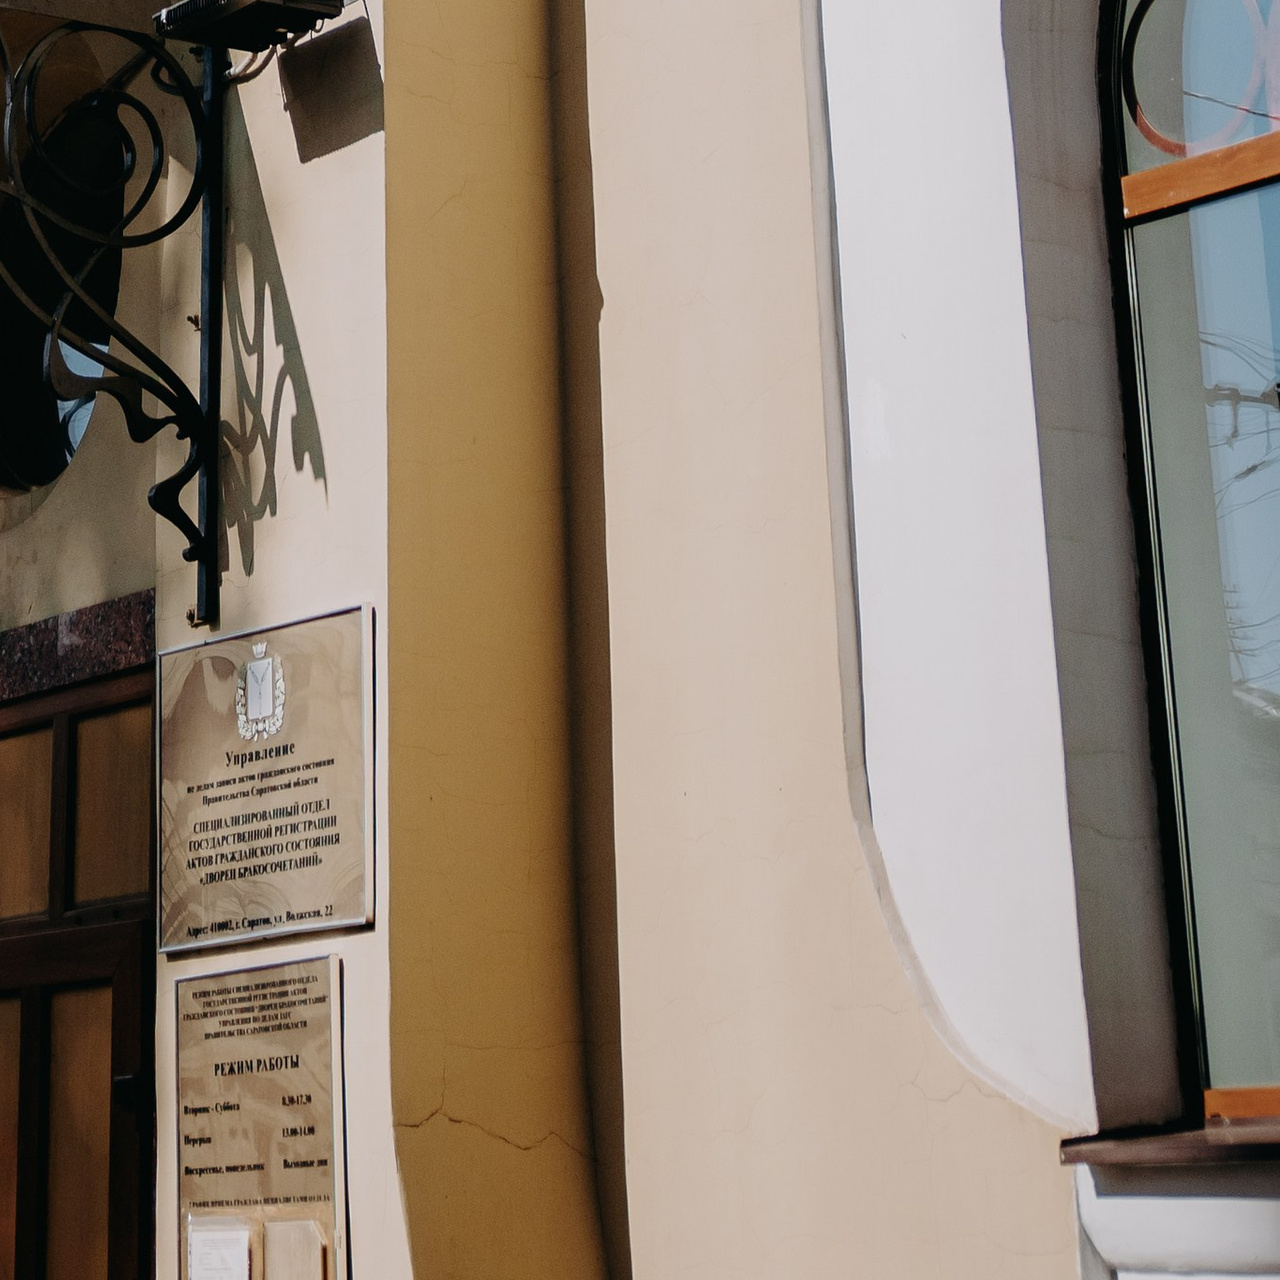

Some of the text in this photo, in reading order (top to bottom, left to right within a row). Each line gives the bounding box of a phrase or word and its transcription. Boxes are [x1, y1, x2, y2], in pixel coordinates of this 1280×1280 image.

[225, 742, 296, 768] Управление
[238, 773, 256, 784] актов
[257, 765, 301, 783] гражданского
[302, 758, 335, 771] состояния
[202, 776, 318, 807] Правительства Саратовской области
[193, 798, 331, 835] СПЕЦИАЛИЗИРОВАННЫЙ ОТДЕЛ
[189, 815, 337, 852] ГОСУДАРСТВЕННОЙ РЕГИСТРАЦИИ
[185, 833, 341, 870] АКТОВ ГРАЖДАНСКОГО СОСТОЯНИЯ
[199, 851, 323, 886] «ДВОРЕЦ БРАКОСОЧЕТАНИЙ»
[186, 926, 209, 938] Адрес:
[325, 905, 333, 917] 22
[214, 1054, 300, 1077] РЕЖИМ РАБОТЫ
[215, 1102, 240, 1115] Суббота
